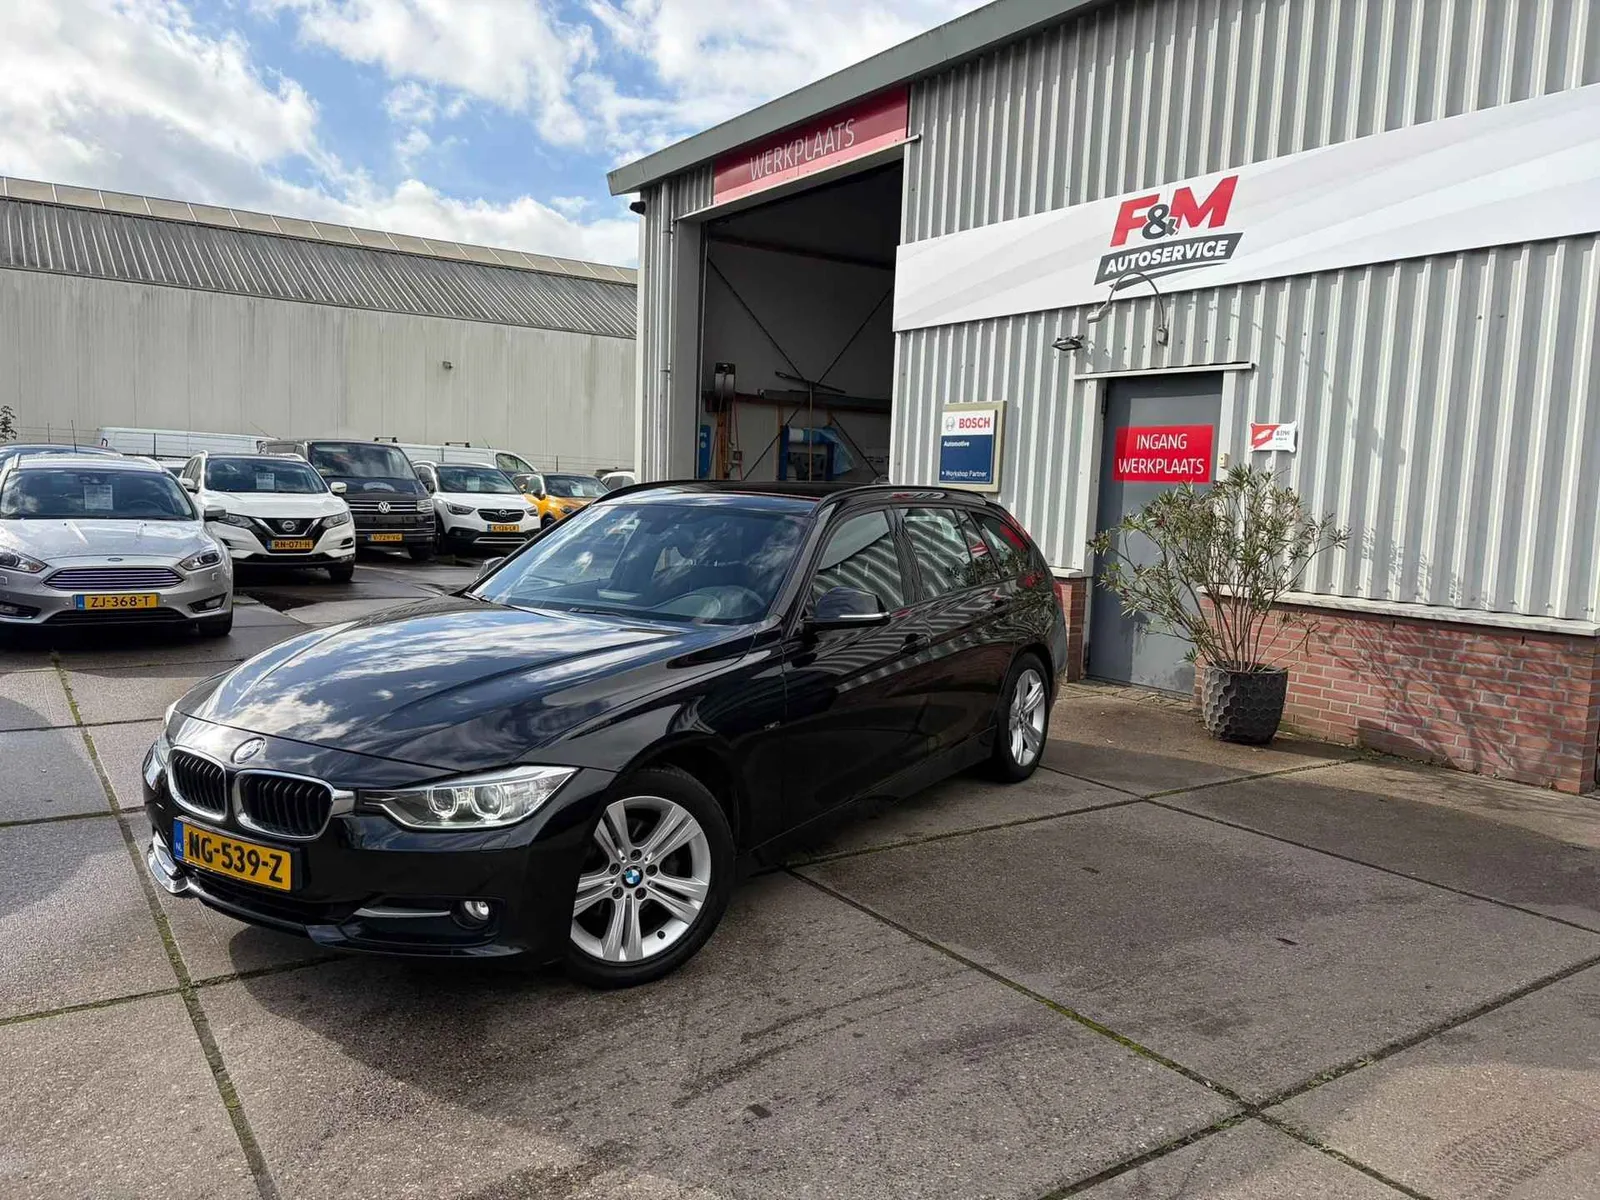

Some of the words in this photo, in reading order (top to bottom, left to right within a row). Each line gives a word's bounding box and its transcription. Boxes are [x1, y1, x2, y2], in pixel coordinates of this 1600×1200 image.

[750, 118, 855, 180] WERKPLAATS
[1110, 175, 1239, 247] F&M
[1104, 239, 1229, 275] AUTOSERVICE
[958, 416, 991, 429] BOSCH
[943, 440, 970, 448] Automotive
[1136, 433, 1188, 450] INGANG
[945, 469, 968, 479] Workshop
[968, 469, 987, 478] Partner
[1118, 457, 1205, 475] WERKPLAATS
[274, 540, 311, 549] RN-071-H
[90, 595, 151, 608] ZJ-368-T
[188, 831, 284, 884] NG-539-Z
